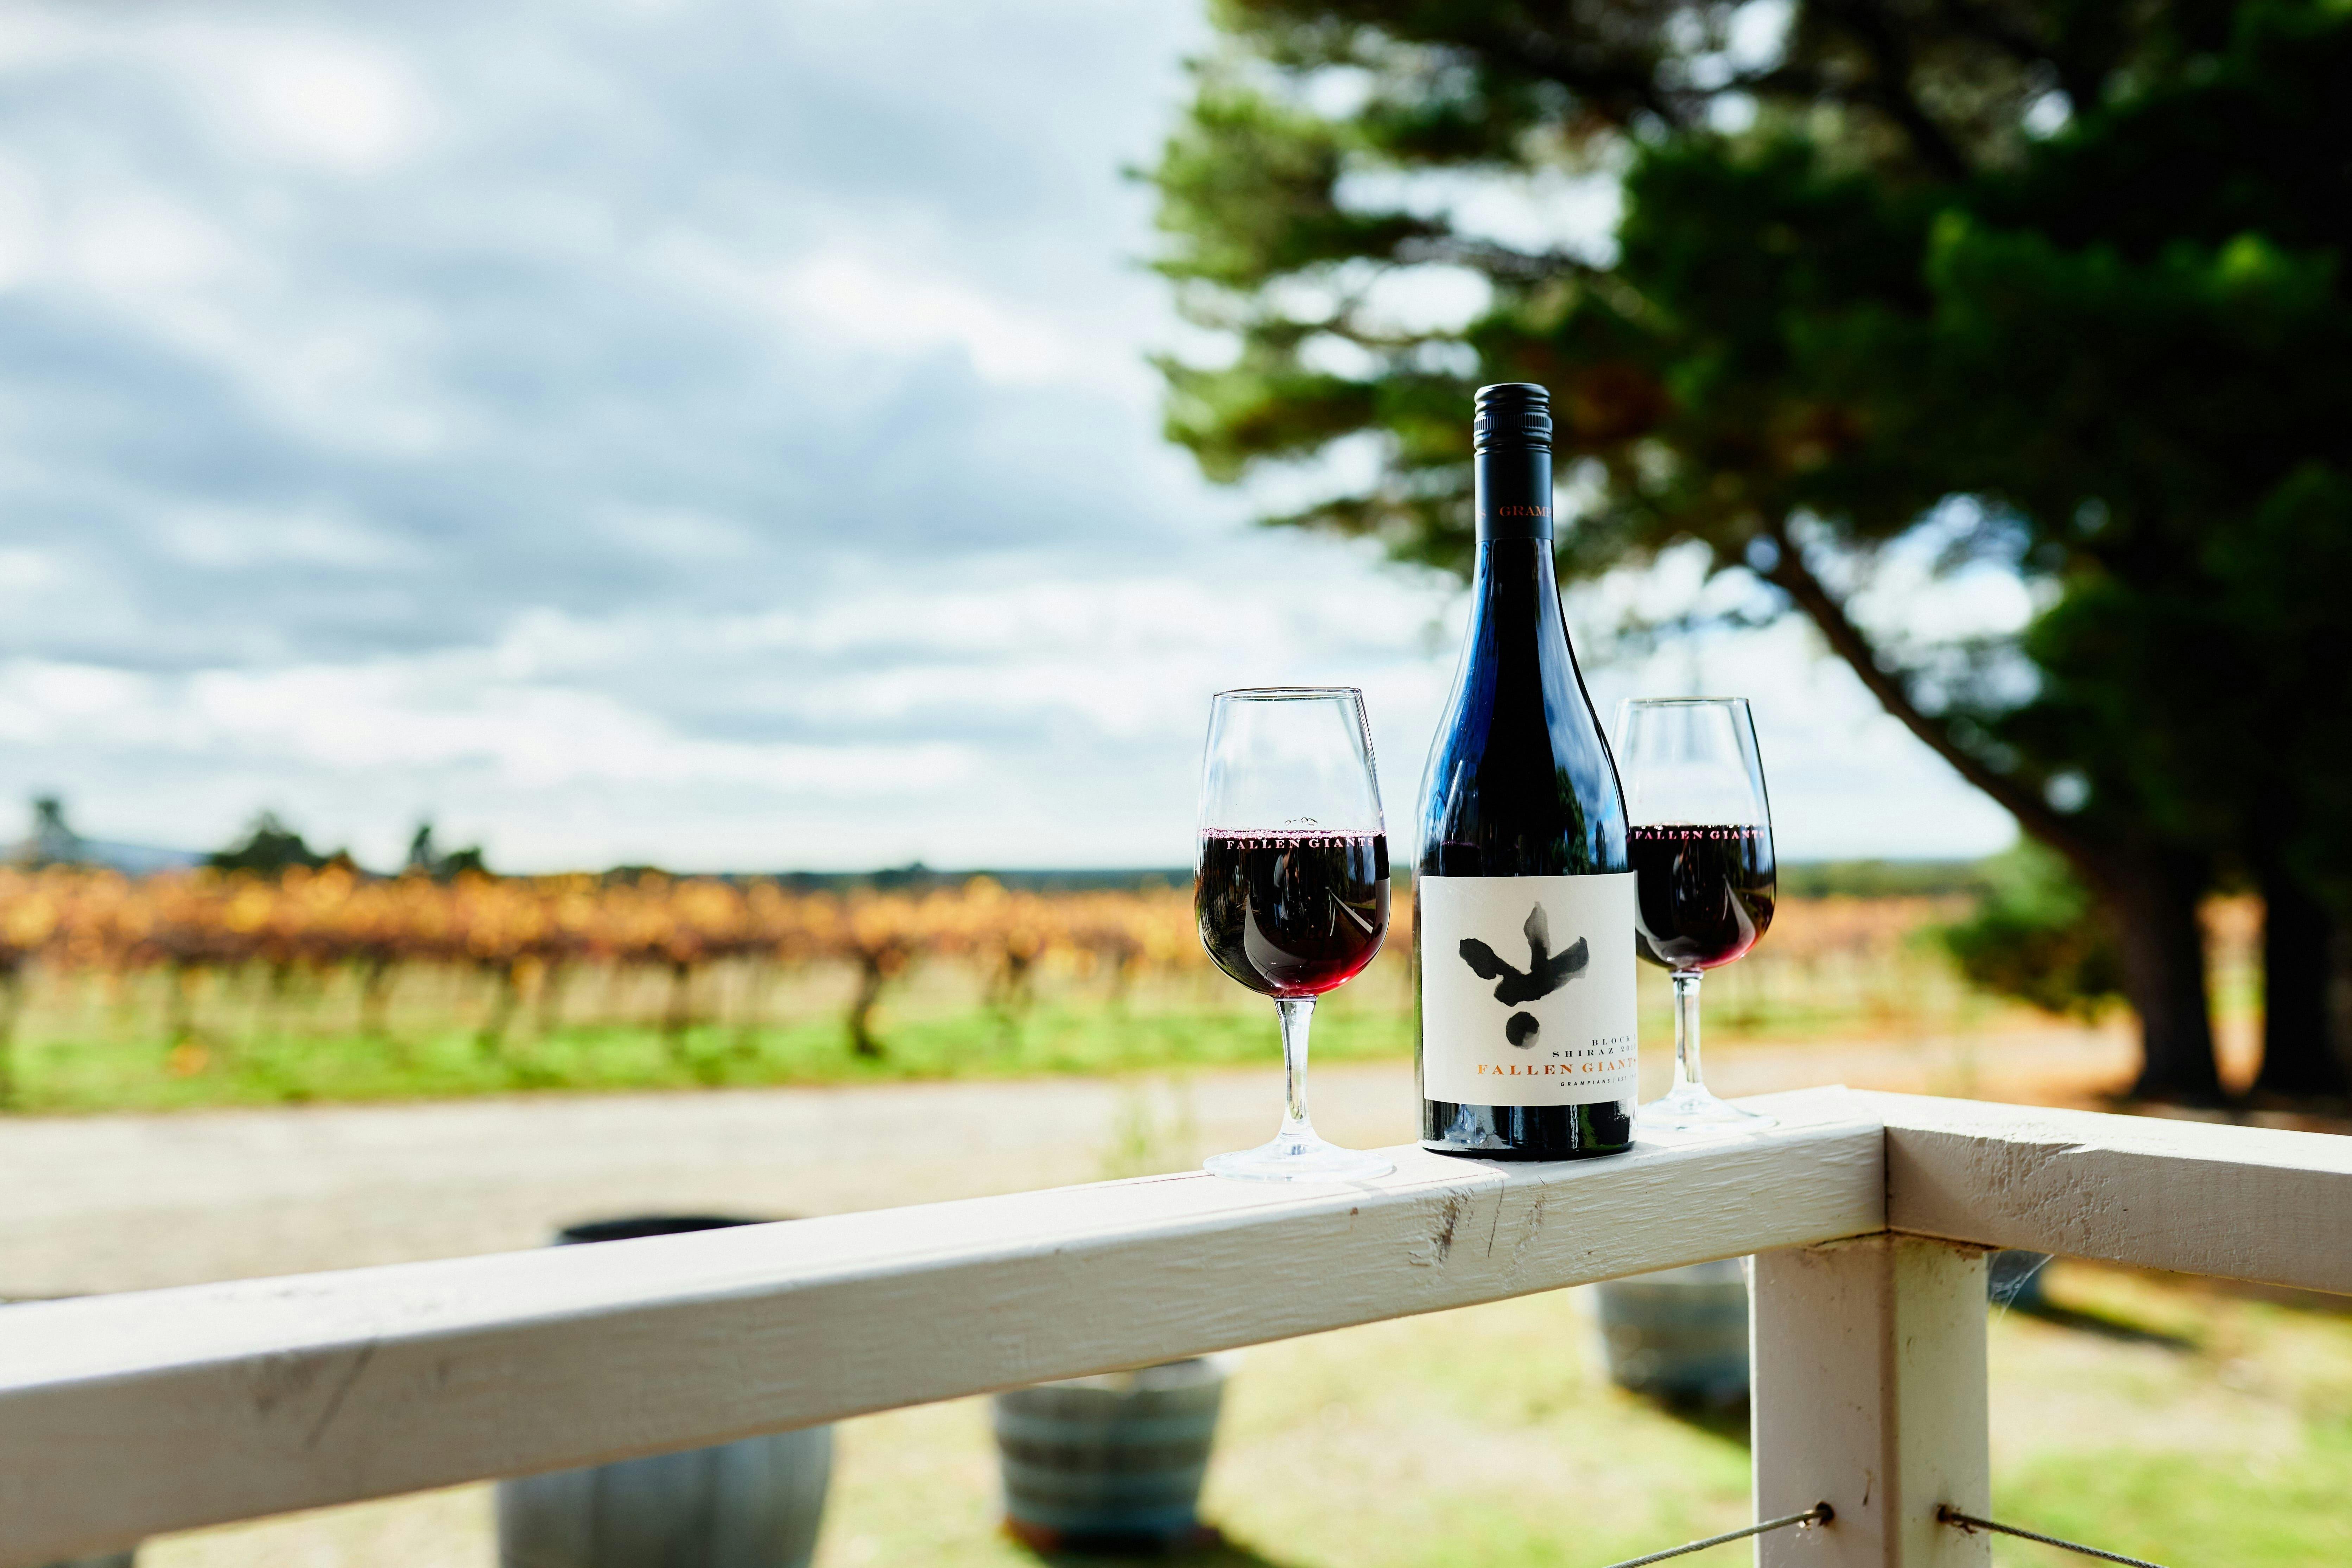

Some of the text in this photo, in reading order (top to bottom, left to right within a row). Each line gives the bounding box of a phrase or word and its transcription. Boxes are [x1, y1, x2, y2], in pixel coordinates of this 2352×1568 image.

[1500, 505, 1553, 518] GRAMP
[1635, 830, 1703, 840] FALLEN
[1227, 838, 1374, 849] FALLEN GIANTS
[1592, 1035, 1630, 1046] BLOCK
[1552, 1048, 1613, 1058] SHIRAZ
[1477, 1064, 1573, 1075] FALLEN
[1560, 1078, 1610, 1087] GRAMPIANS
